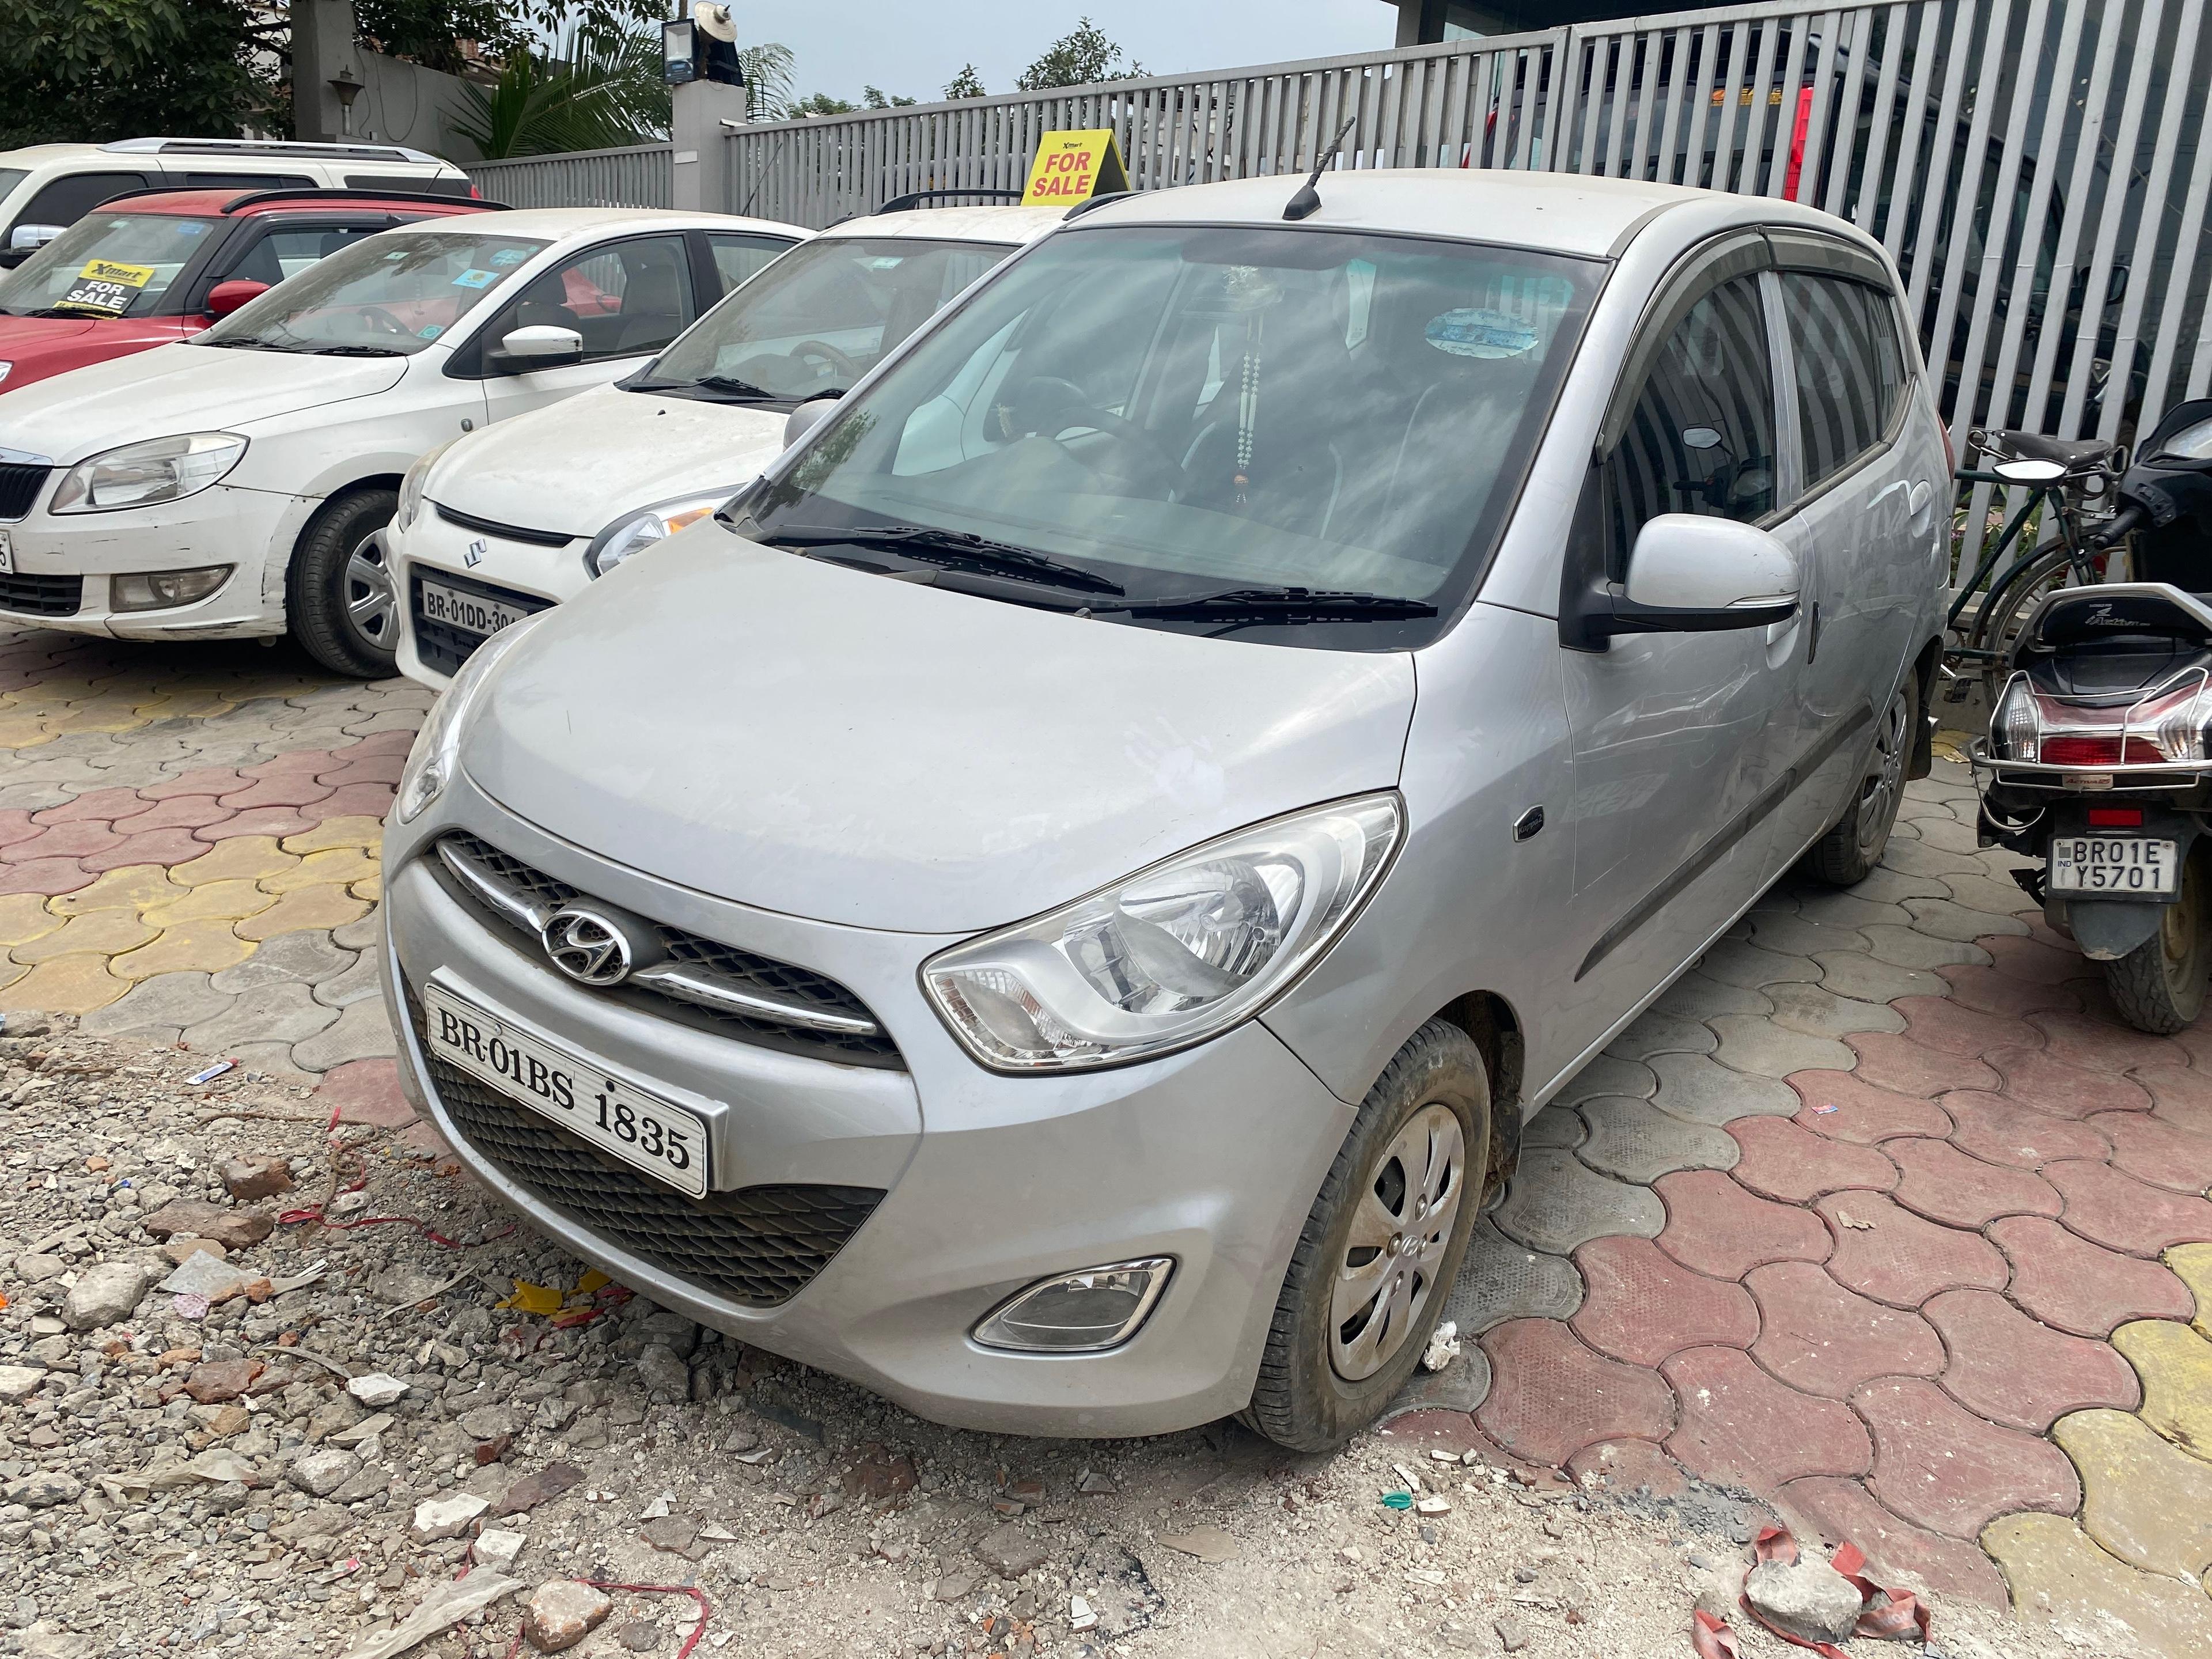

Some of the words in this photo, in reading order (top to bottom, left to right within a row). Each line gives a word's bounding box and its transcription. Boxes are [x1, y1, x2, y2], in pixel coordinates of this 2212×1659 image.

[1044, 151, 1091, 173] FOR
[1032, 175, 1091, 197] SALE
[91, 263, 143, 278] Xmart
[66, 290, 128, 309] SALE
[85, 281, 126, 296] FOR
[2074, 842, 2160, 864] BR01E
[2077, 866, 2160, 888] Y5701
[438, 1007, 575, 1111] BR-01BS
[594, 1093, 690, 1170] 1835
